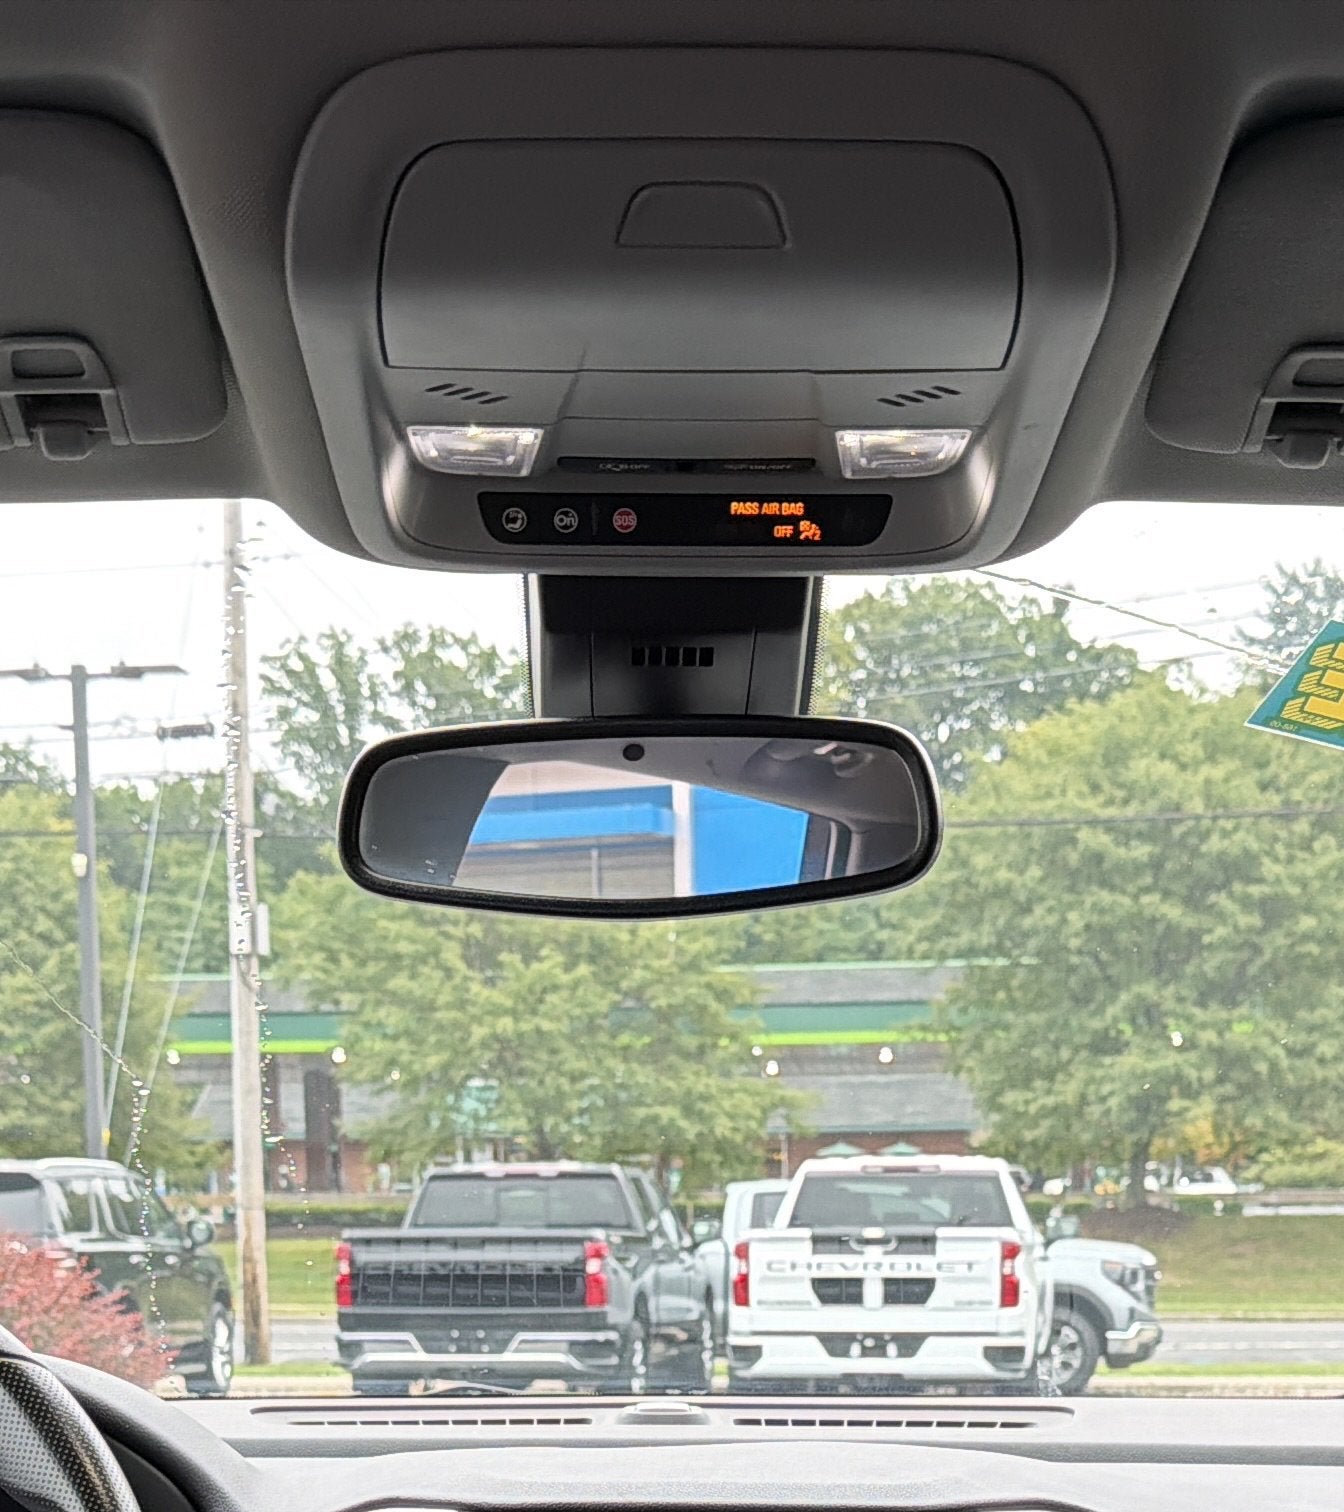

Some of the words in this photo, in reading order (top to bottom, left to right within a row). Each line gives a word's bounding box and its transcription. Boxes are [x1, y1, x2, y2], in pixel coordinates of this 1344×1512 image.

[730, 502, 759, 515] PASS
[761, 502, 780, 515] AIR
[782, 502, 804, 515] BAG
[614, 513, 636, 527] SOS
[774, 525, 793, 538] OFF
[765, 1260, 977, 1274] CHEVROLET
